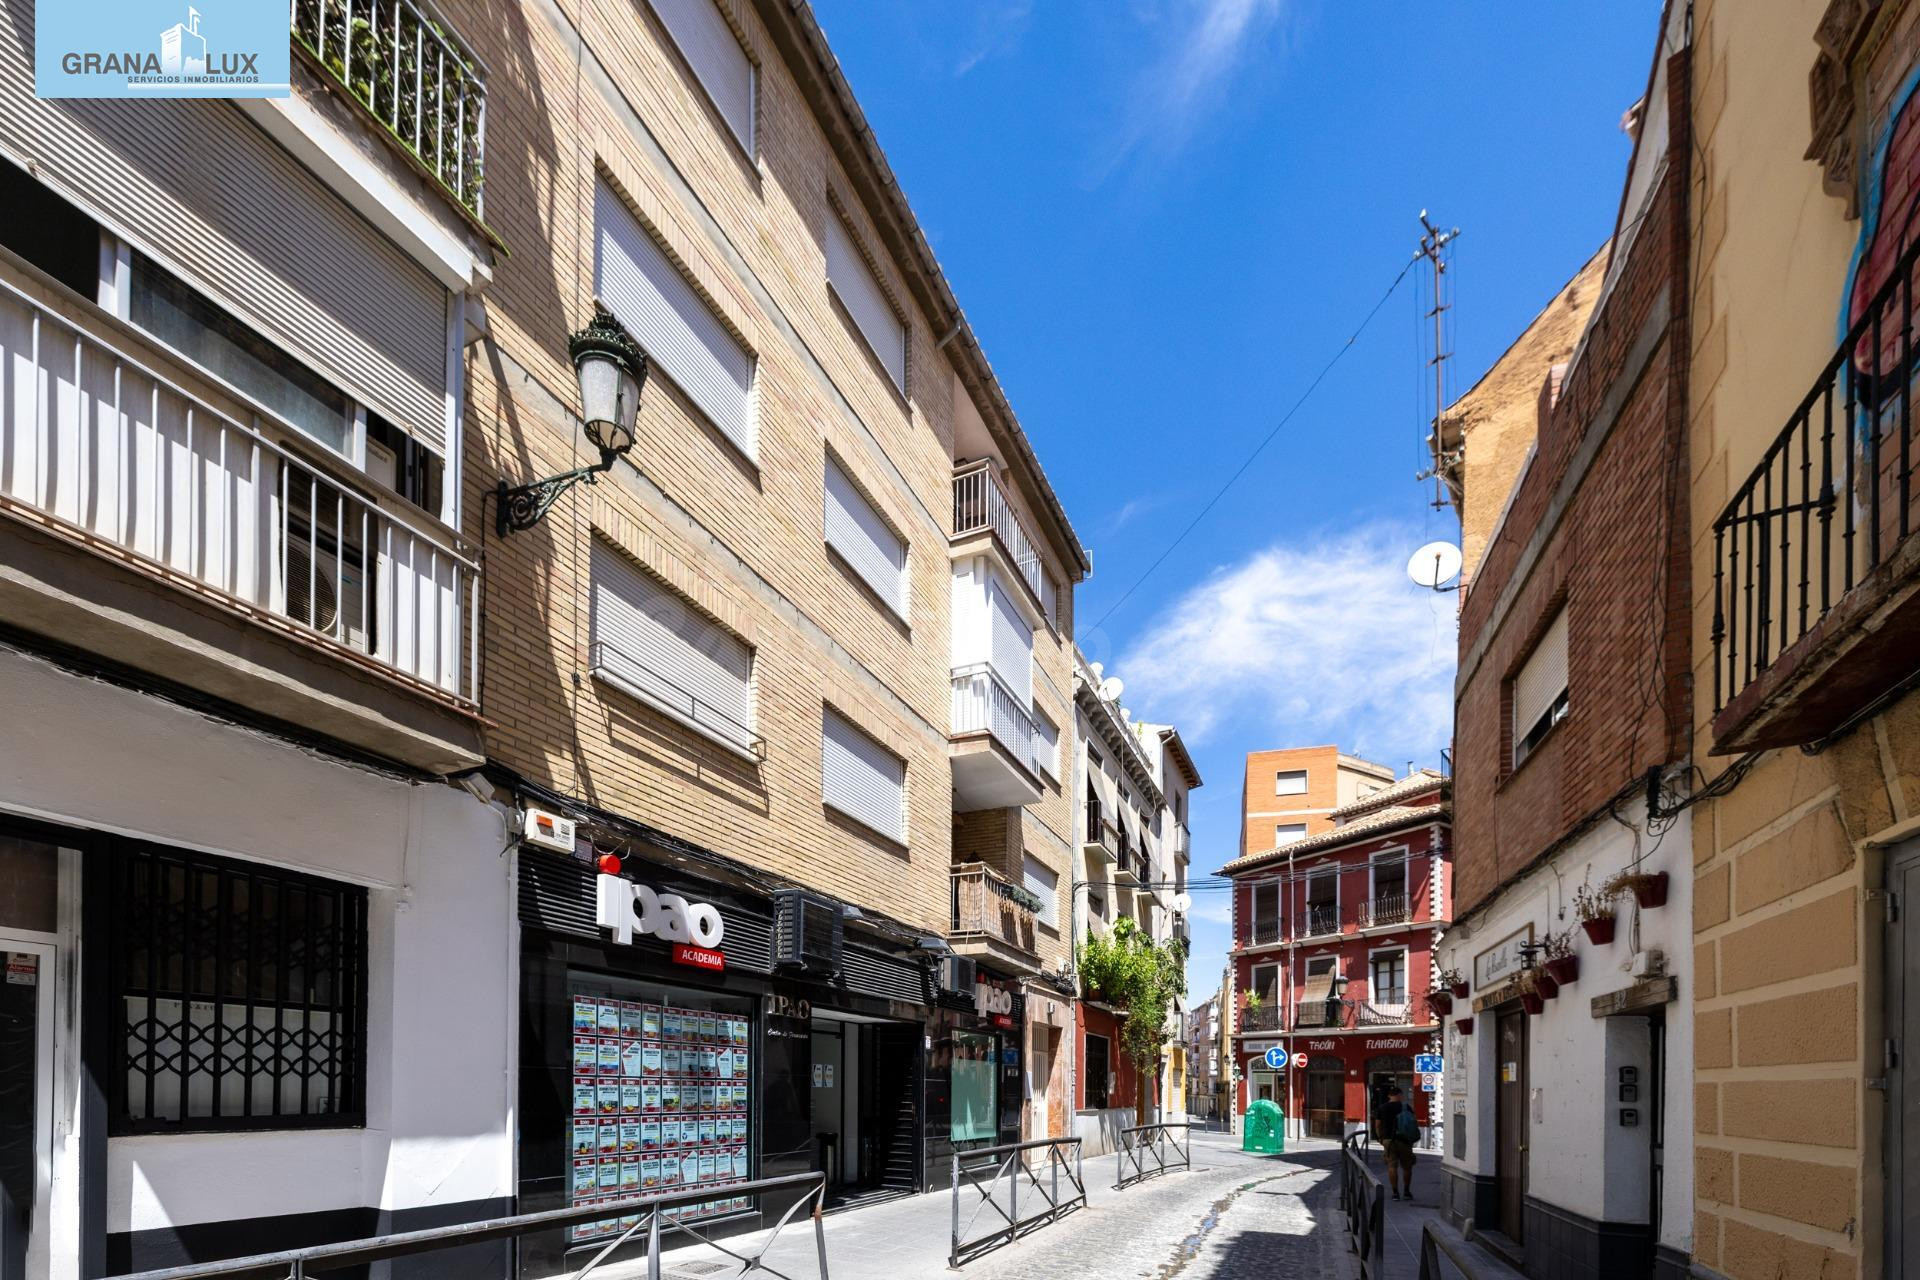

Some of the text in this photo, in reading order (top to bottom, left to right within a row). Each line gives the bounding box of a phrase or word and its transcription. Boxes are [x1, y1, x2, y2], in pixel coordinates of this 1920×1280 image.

[681, 949, 723, 967] ACADEMIA
[1309, 1039, 1409, 1050] TACÓN FLAMENCO
